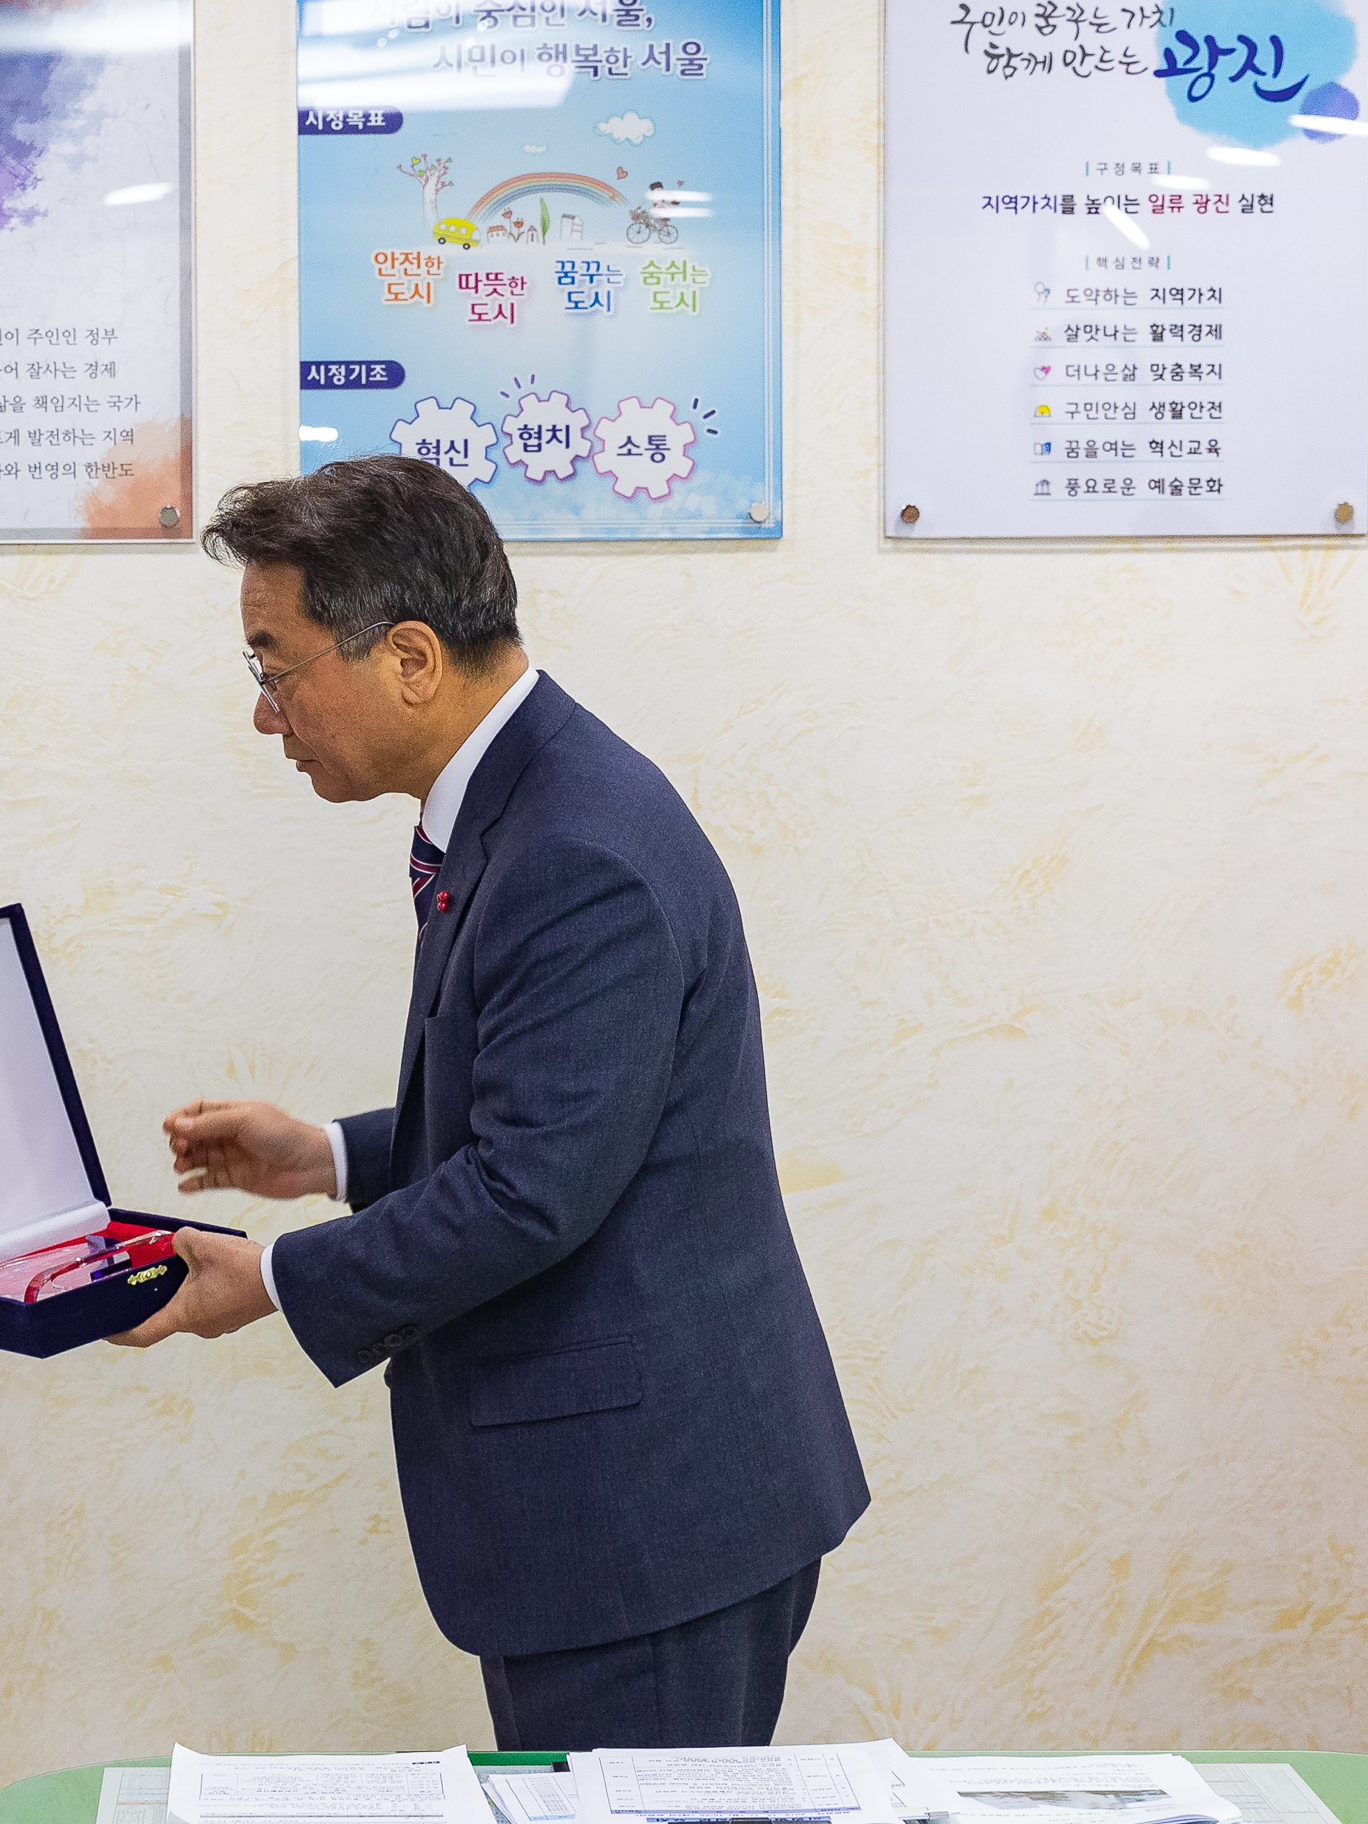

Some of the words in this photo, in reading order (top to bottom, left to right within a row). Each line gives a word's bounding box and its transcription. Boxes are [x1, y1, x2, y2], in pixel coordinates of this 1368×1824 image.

[577, 0, 655, 29] 서울,
[950, 3, 1026, 53] 구민이
[1035, 1, 1116, 40] 꿈꾸는
[1122, 5, 1174, 29] 가치
[433, 43, 526, 78] 시민이
[536, 42, 632, 78] 행복한
[641, 41, 708, 77] 서울
[984, 42, 1053, 79] 함께
[1063, 45, 1148, 78] 만드는
[1153, 30, 1310, 102] 광진
[305, 109, 387, 131] 시정목표
[982, 194, 1076, 216] 지역가치를
[1085, 194, 1140, 216] 높이는
[1148, 194, 1185, 216] 일류
[1192, 194, 1229, 216] 광진
[1237, 194, 1274, 216] 실현
[373, 250, 444, 279] 안전한
[554, 259, 625, 286] 꿈꾸는
[640, 258, 711, 286] 숨쉬는
[385, 281, 432, 305] 도시
[457, 271, 528, 298] 따뜻한
[1064, 287, 1138, 305] 도약하는
[1149, 287, 1223, 305] 지역가치
[468, 301, 516, 324] 도시
[564, 289, 613, 313] 도시
[649, 289, 698, 313] 도시
[26, 328, 78, 346] 주인인
[84, 328, 118, 346] 정부
[1064, 323, 1138, 342] 살맛나는
[1149, 323, 1223, 342] 활력경제
[26, 362, 77, 380] 잘사는
[83, 362, 117, 380] 경제
[307, 364, 389, 385] 시정기조
[1064, 362, 1138, 381] 더나은삶
[1149, 362, 1223, 381] 맞춤복지
[32, 395, 100, 413] 책임지는
[107, 395, 141, 413] 국가
[1064, 400, 1138, 420] 구민안심
[1149, 400, 1223, 420] 생활안전
[27, 428, 95, 446] 발전하는
[102, 428, 134, 446] 지역
[517, 424, 571, 455] 협치
[1064, 439, 1138, 458] 꿈을여는
[1149, 439, 1223, 458] 혁신교육
[415, 438, 470, 467] 혁신
[616, 435, 671, 464] 소통
[27, 461, 77, 480] 번영의
[84, 461, 135, 480] 한반도
[1064, 477, 1138, 497] 풍요로운
[1149, 477, 1223, 497] 예술문화
